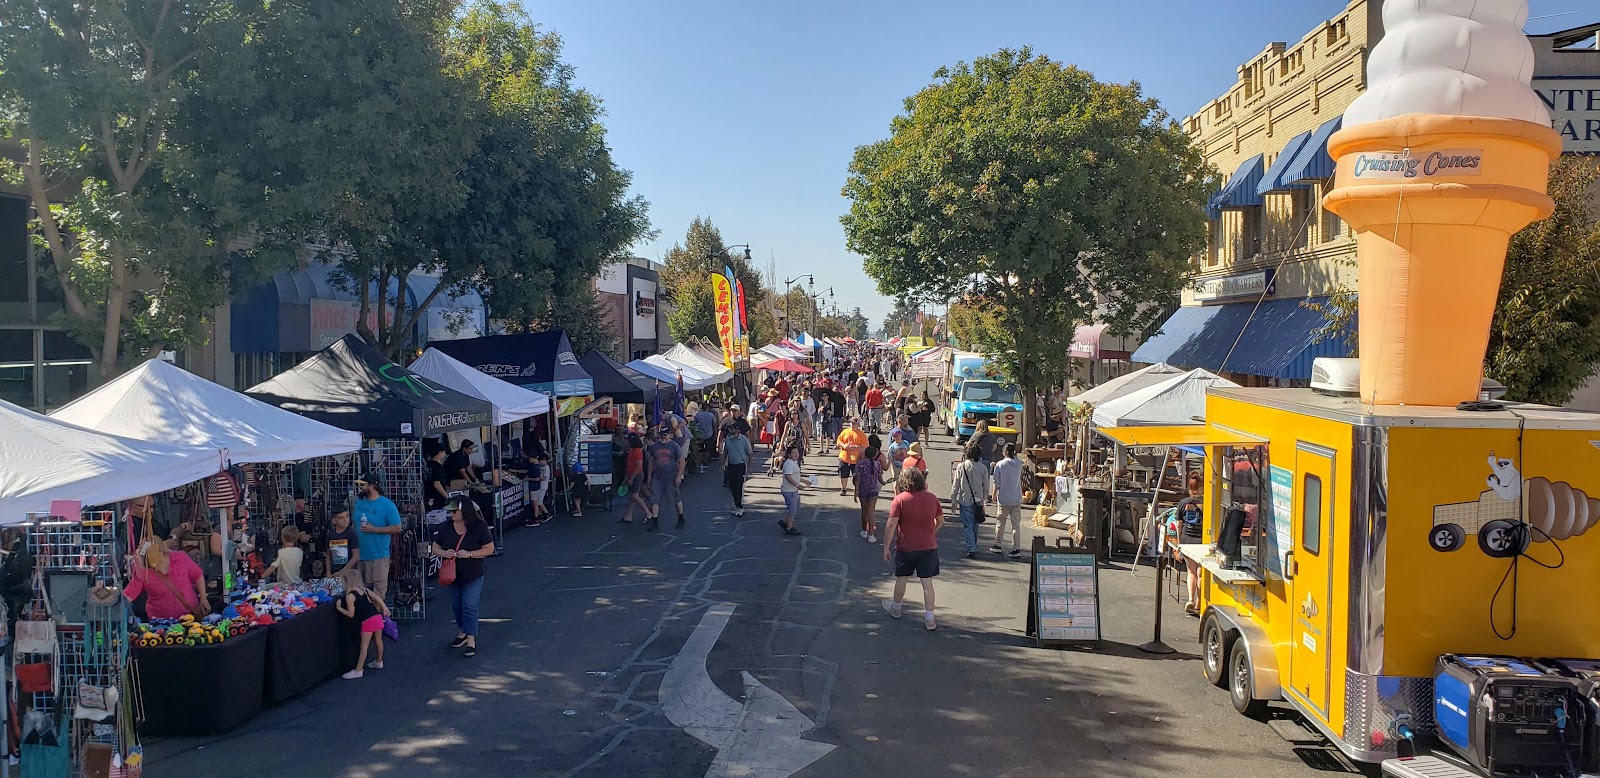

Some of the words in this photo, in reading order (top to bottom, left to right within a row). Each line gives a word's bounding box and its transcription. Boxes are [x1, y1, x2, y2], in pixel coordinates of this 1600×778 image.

[1355, 155, 1421, 177] Cruising
[1423, 152, 1480, 175] Cones
[313, 308, 347, 329] TWICE
[446, 412, 467, 426] ENERGY
